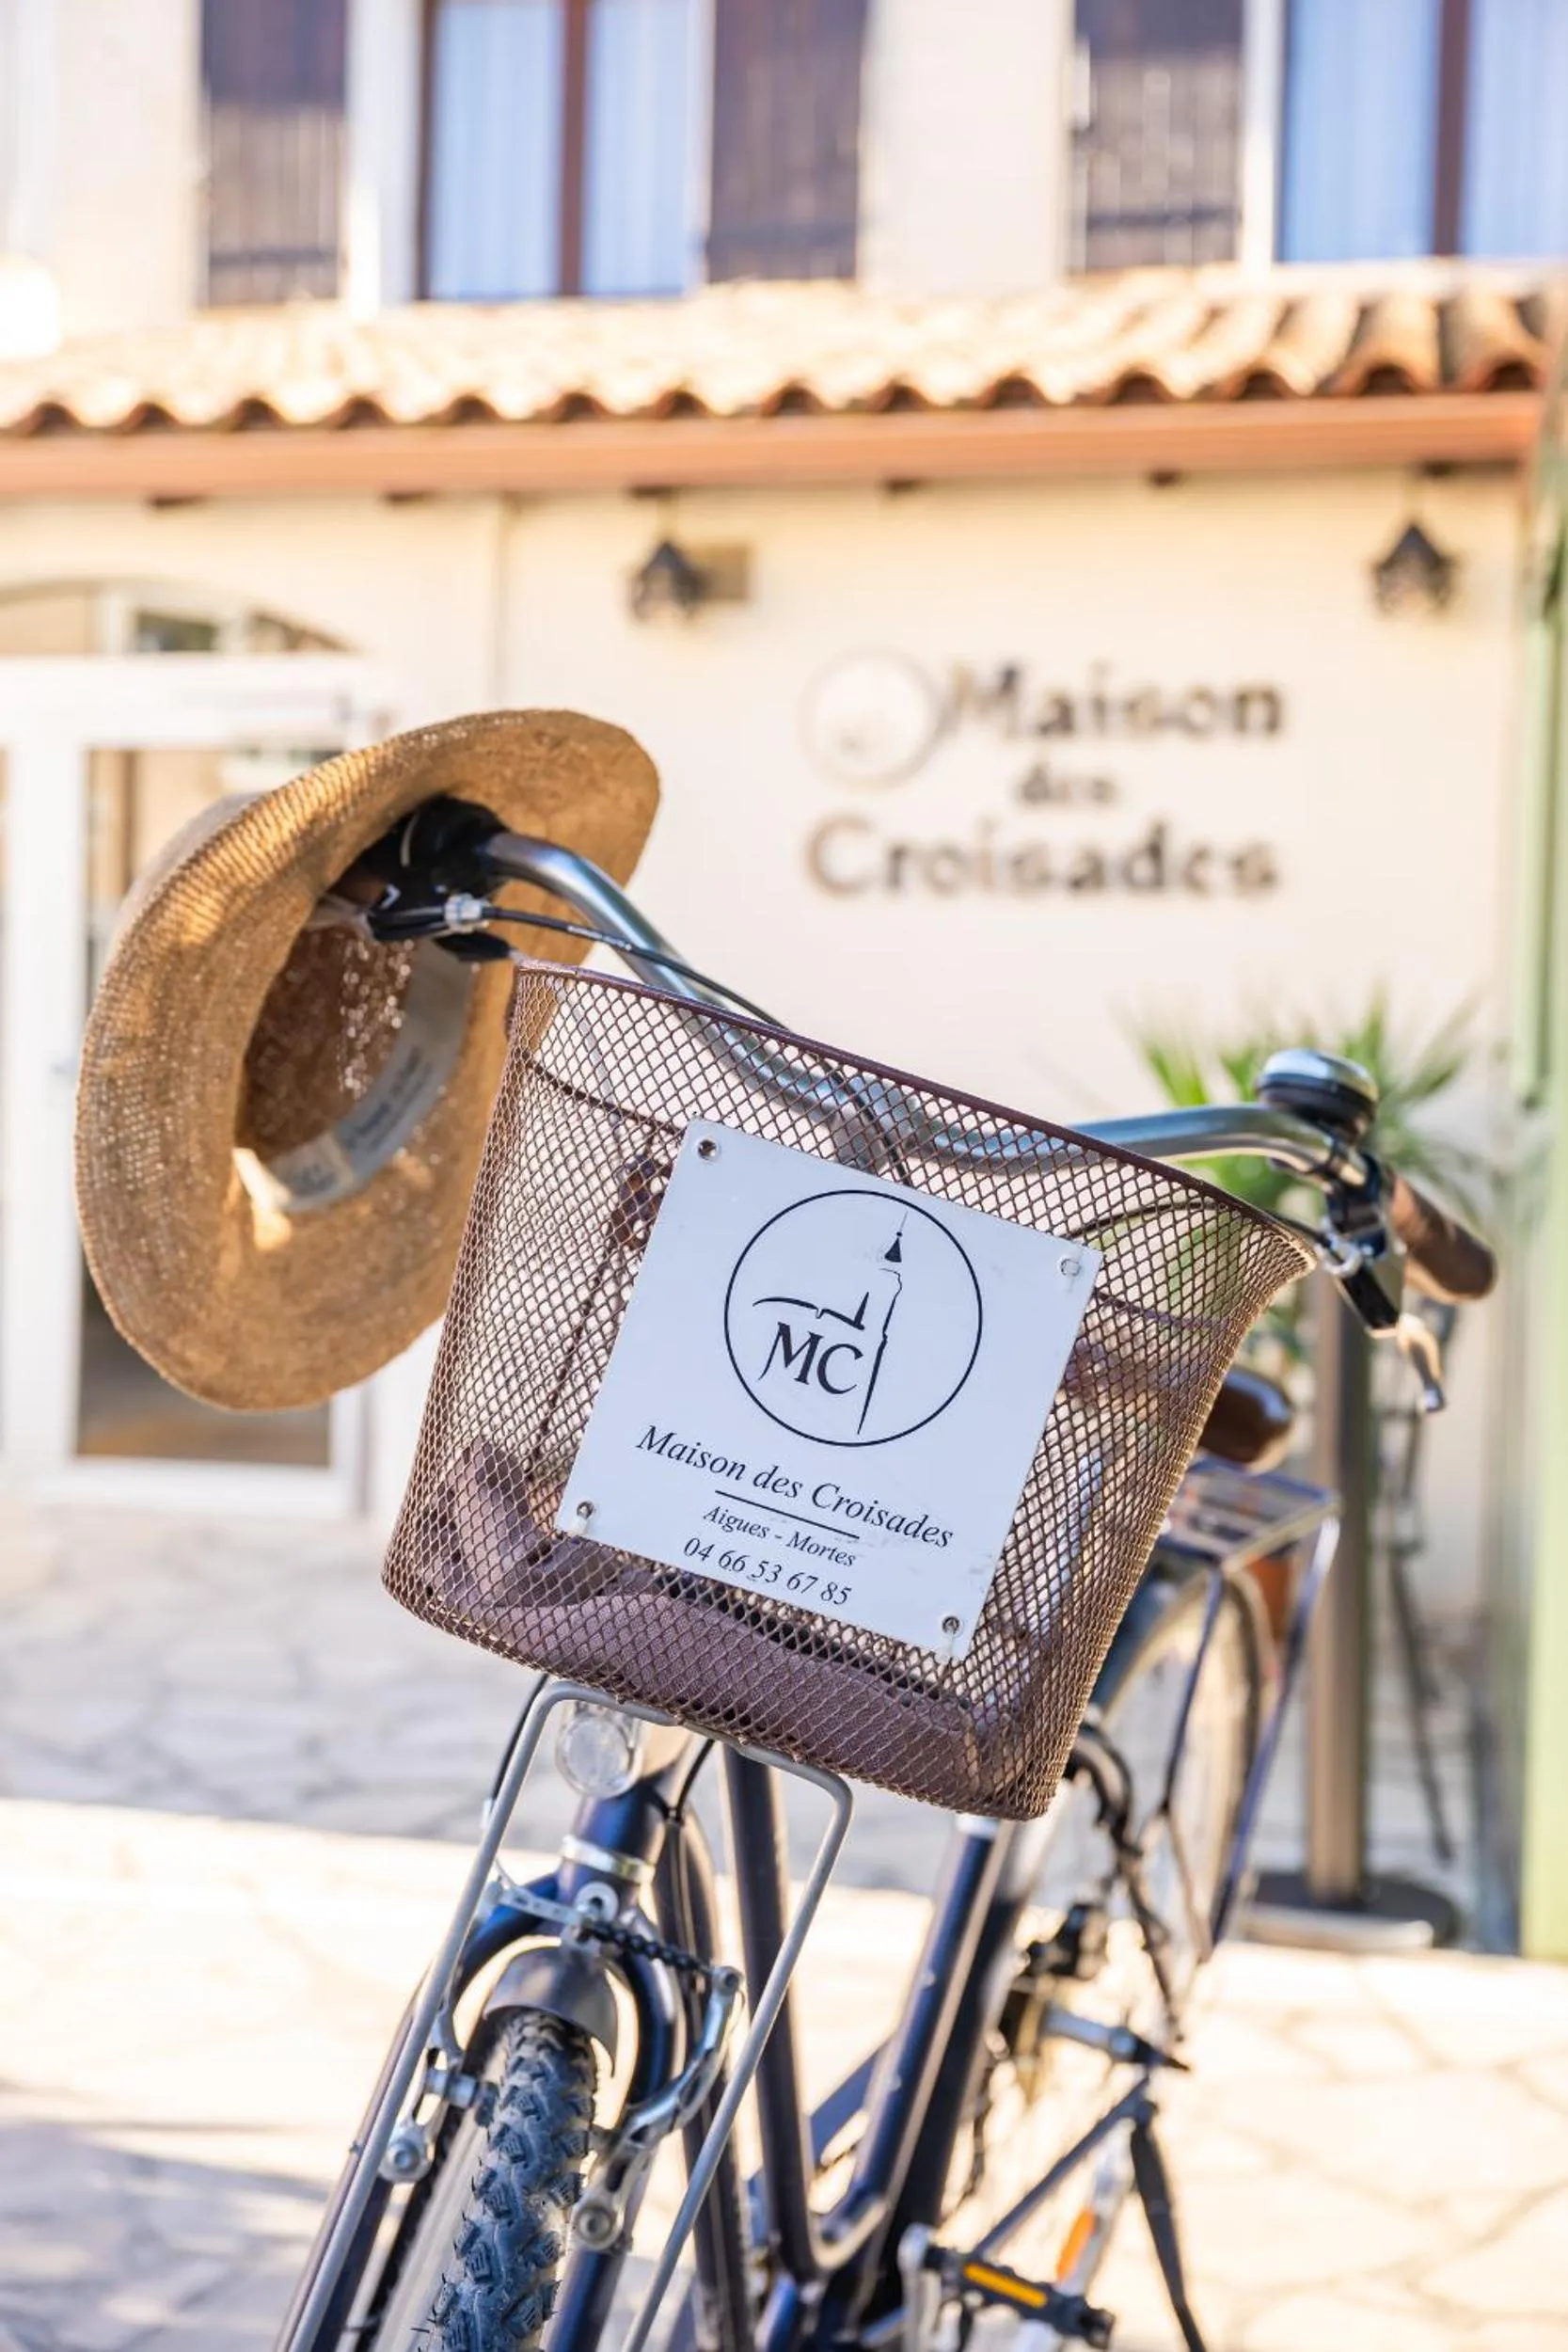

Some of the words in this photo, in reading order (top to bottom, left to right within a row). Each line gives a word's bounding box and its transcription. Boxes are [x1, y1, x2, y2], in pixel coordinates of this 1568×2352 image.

[943, 659, 1289, 741] Maison
[803, 813, 1279, 900] Croisades
[758, 1322, 864, 1395] MC
[636, 1424, 747, 1482] Maison
[752, 1465, 803, 1499] des
[811, 1482, 954, 1549] Croisades
[683, 1537, 715, 1562] 04
[718, 1549, 747, 1574] 66
[750, 1560, 783, 1583] 53
[785, 1571, 818, 1595] 67
[819, 1581, 853, 1606] 85
[703, 1505, 770, 1539] Aigues
[785, 1531, 856, 1567] Mortes
